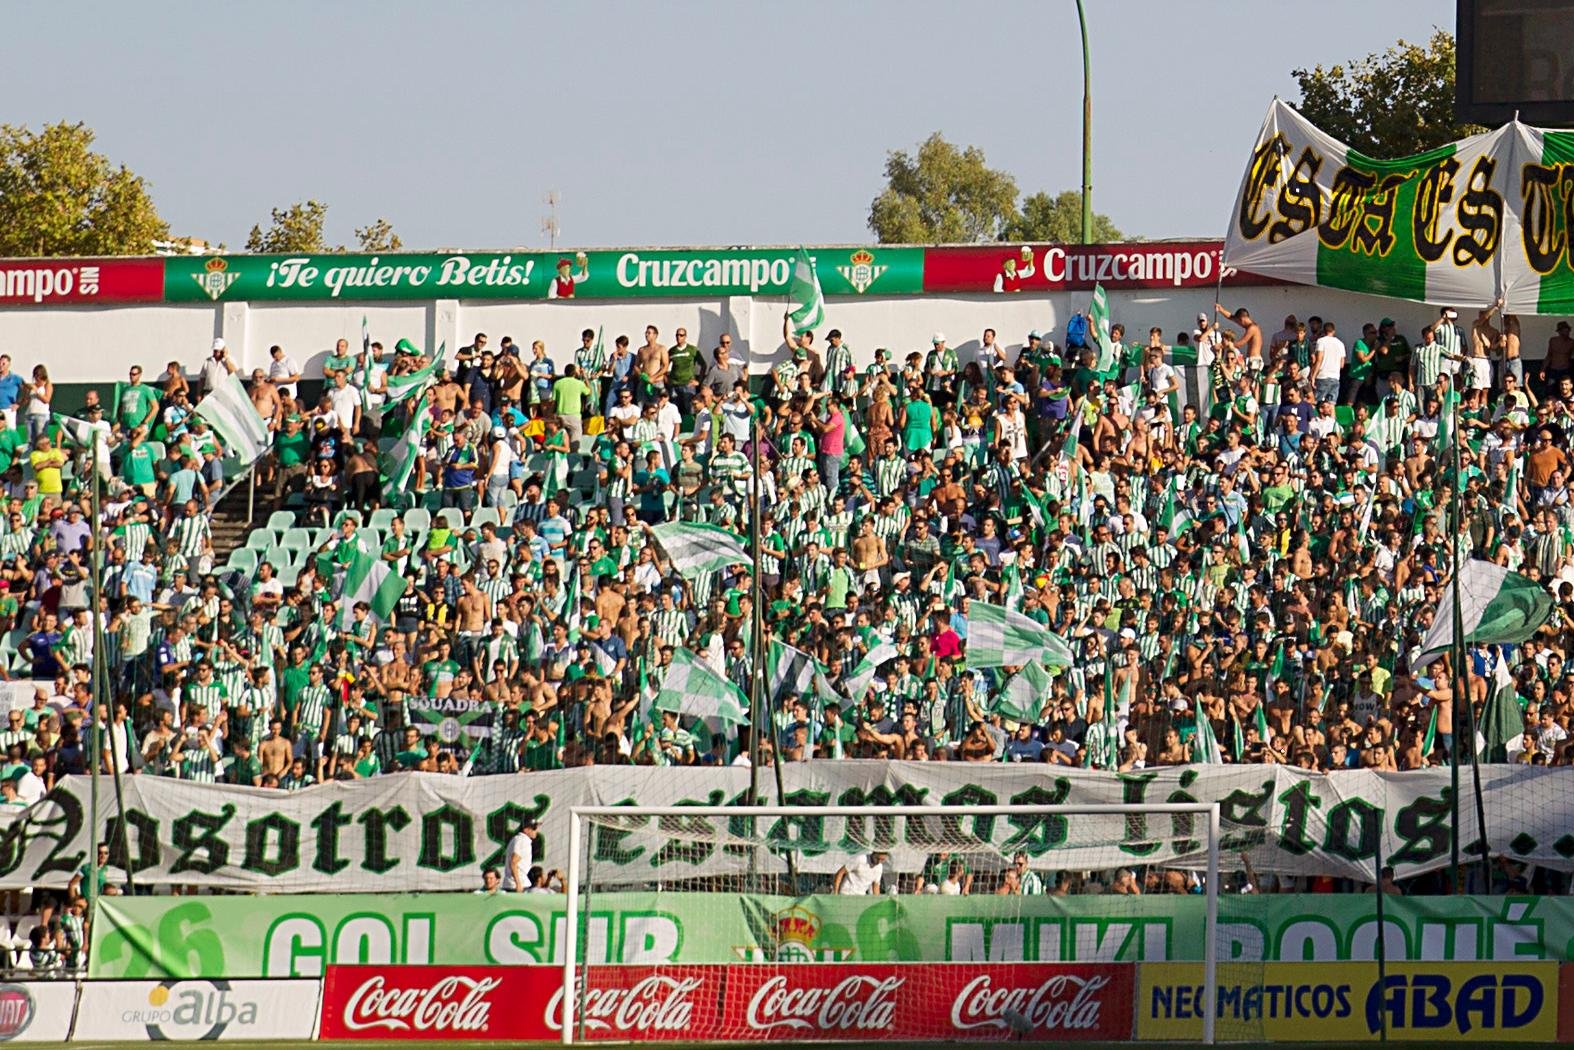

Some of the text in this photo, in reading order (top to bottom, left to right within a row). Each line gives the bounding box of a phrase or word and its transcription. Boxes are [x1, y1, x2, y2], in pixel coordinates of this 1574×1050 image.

[1238, 131, 1418, 258] ESTA
[1411, 155, 1500, 267] ES
[80, 267, 99, 295] SIN
[266, 256, 536, 300] ¡Te quiero Betis!
[616, 252, 791, 293] Cruzcampo
[1044, 246, 1213, 287] Cruzcampo
[410, 698, 492, 713] SQUADRA
[0, 788, 553, 882] Nosotros
[593, 774, 1070, 867] estamos
[0, 999, 25, 1025] IAT
[121, 981, 258, 1026] GRUPO alba
[344, 974, 503, 1032] Coca-Cola
[749, 974, 907, 1032] Coca-Cola
[952, 974, 1110, 1032] Coca-Cola
[1364, 973, 1546, 1035] ABAD
